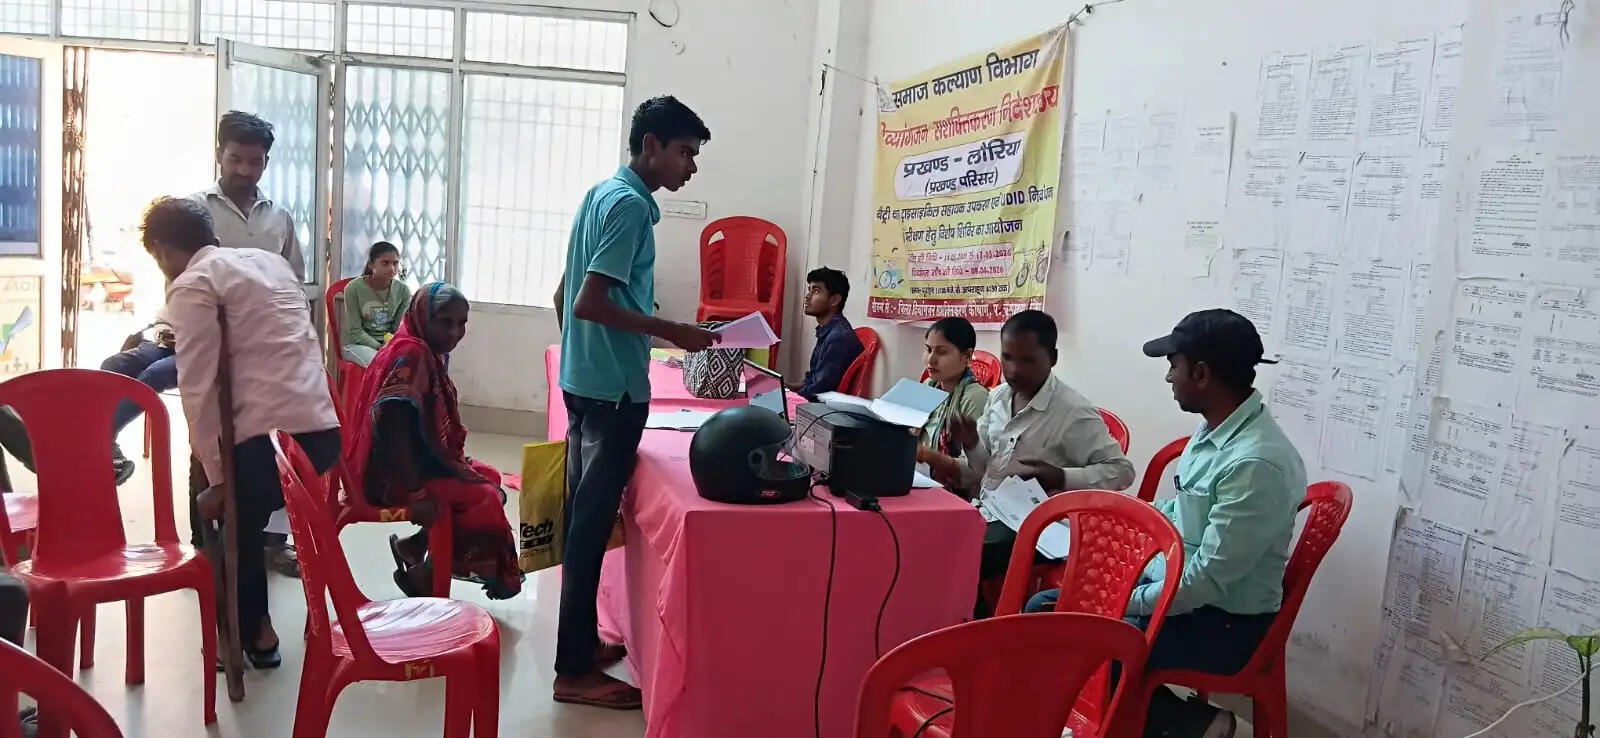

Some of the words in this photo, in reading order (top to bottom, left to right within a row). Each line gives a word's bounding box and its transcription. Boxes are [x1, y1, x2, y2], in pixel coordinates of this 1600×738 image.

[891, 82, 929, 109] समाज
[932, 65, 983, 97] कल्याण
[985, 49, 1040, 82] विभाग
[879, 118, 929, 149] िव्यांगजन
[903, 156, 950, 179] प्रखण्ड
[966, 138, 1022, 166] लौरिया
[924, 177, 957, 197] (प्रखण्ड
[958, 167, 998, 188] परिसर)
